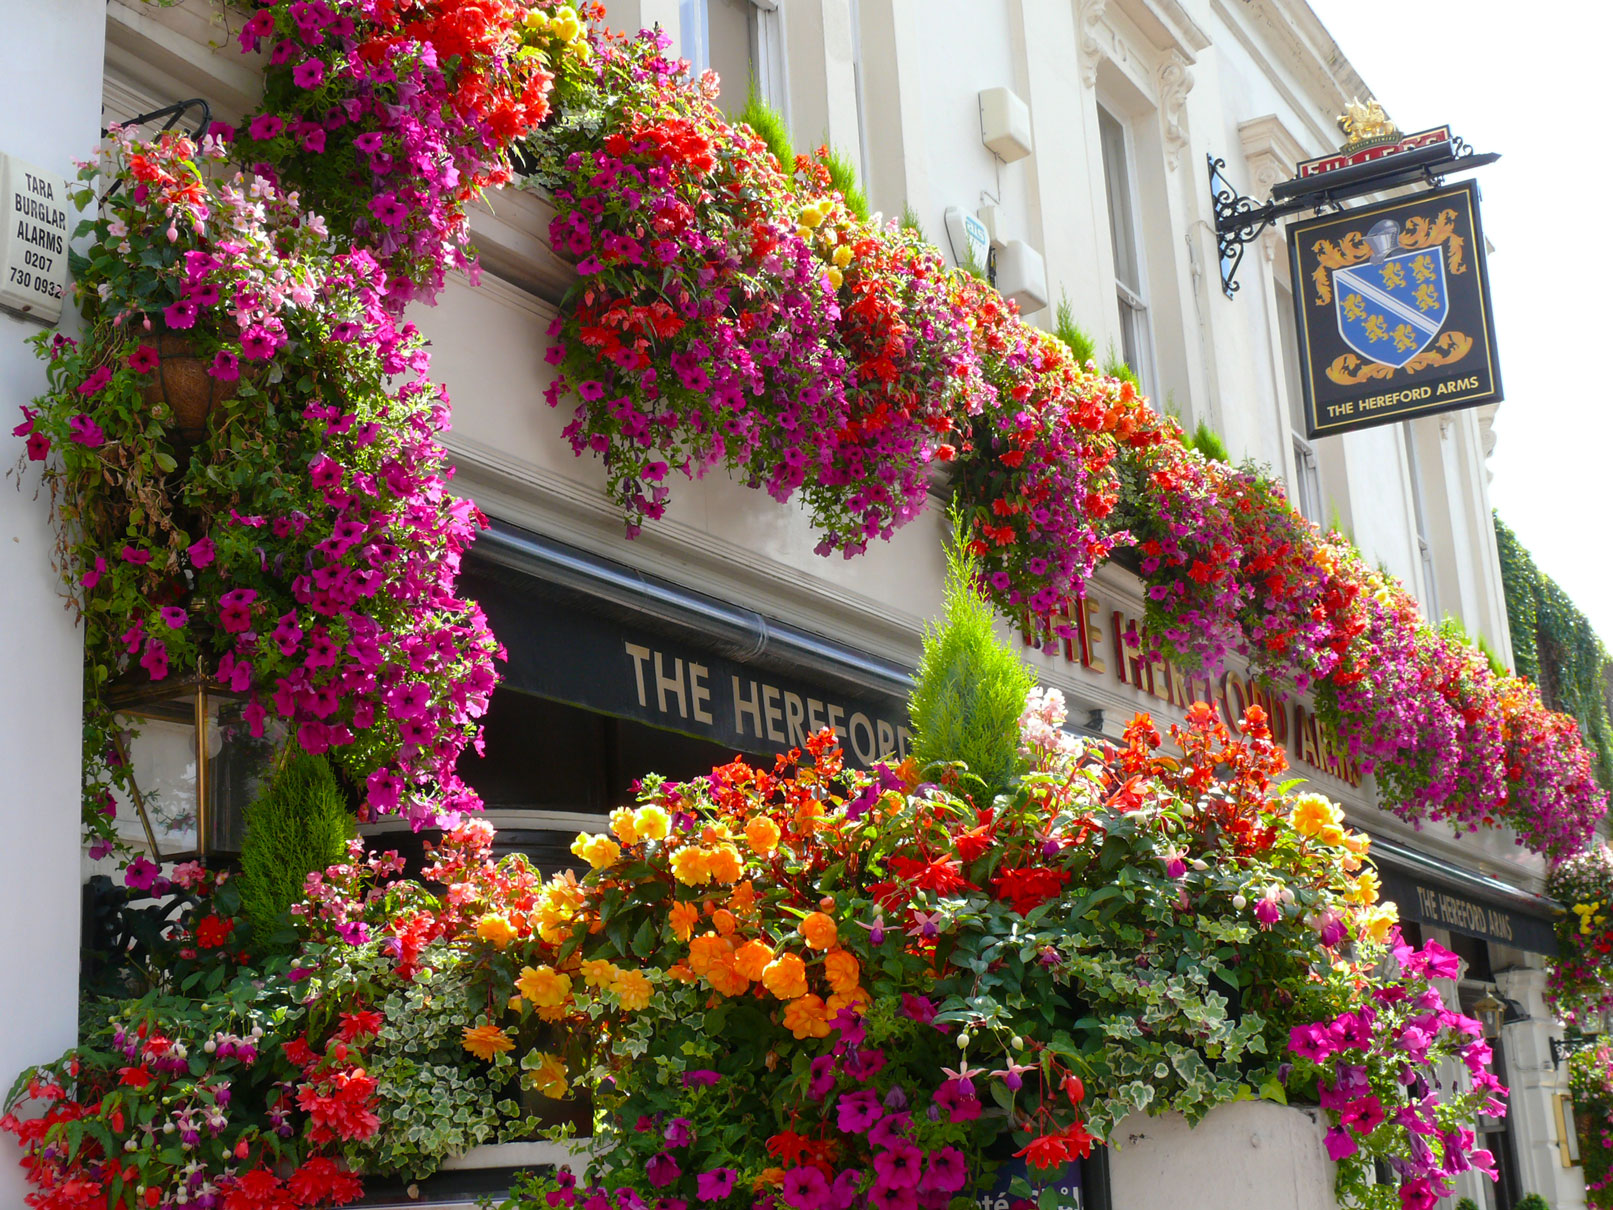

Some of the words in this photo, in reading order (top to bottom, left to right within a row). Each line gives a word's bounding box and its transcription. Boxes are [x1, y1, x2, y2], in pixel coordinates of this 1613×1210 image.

[25, 173, 54, 201] TARA
[15, 193, 66, 231] BURGLAR
[17, 220, 63, 255] ALARMS
[10, 266, 31, 288] 730
[24, 250, 53, 273] 0207
[1327, 402, 1354, 417] THE
[1358, 386, 1431, 411] HEREFORD
[1436, 376, 1479, 395] ARMS
[625, 641, 713, 725] THE
[1416, 886, 1438, 920] THE
[1438, 893, 1487, 934] HEREFORD
[1488, 909, 1513, 942] ARMS
